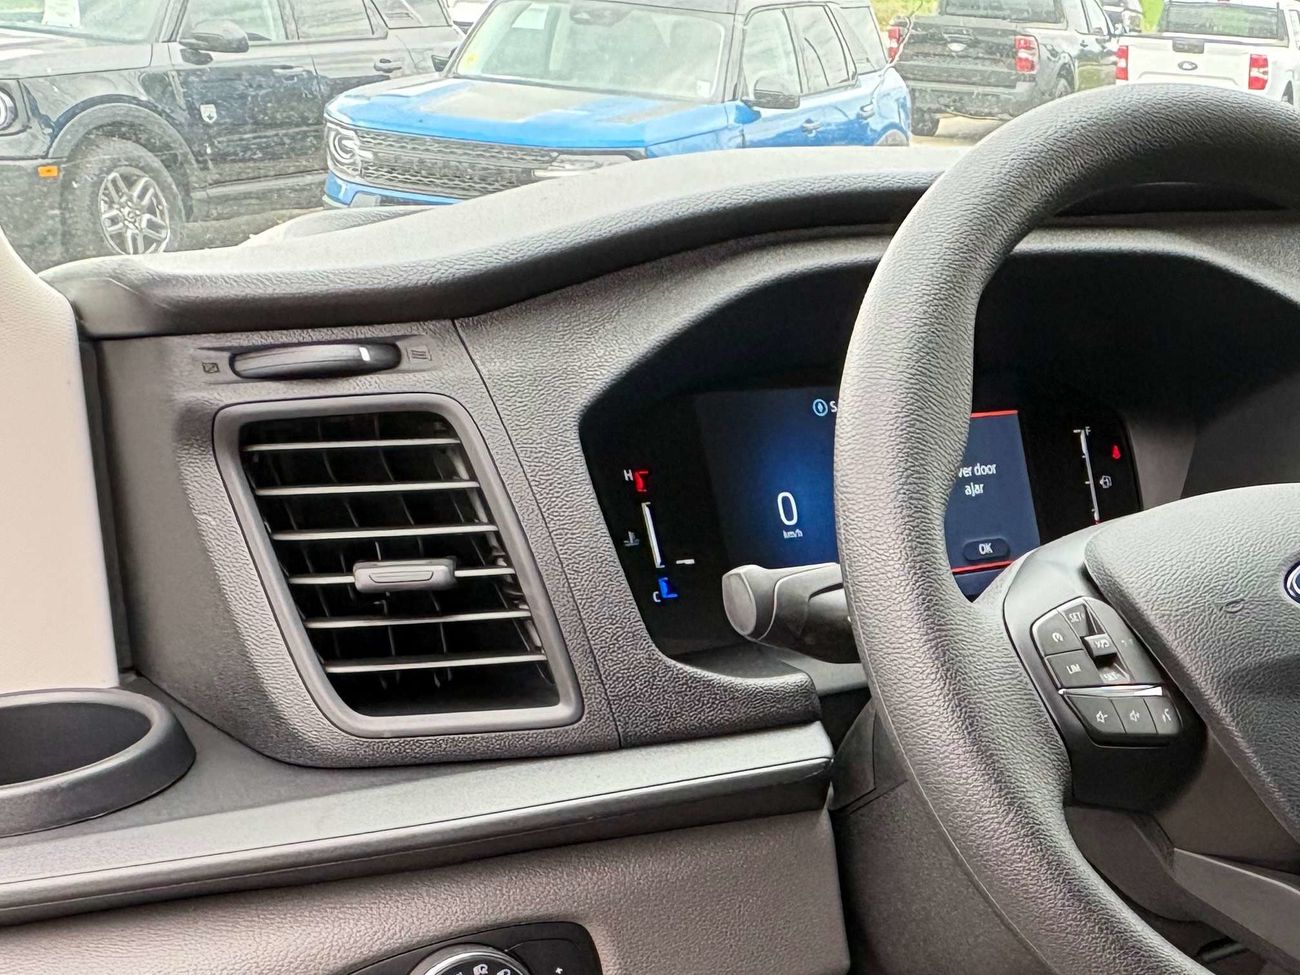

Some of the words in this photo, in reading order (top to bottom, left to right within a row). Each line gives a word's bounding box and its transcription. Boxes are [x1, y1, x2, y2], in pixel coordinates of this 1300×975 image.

[623, 469, 634, 481] H
[974, 462, 997, 476] door
[964, 482, 984, 497] ajar
[777, 491, 798, 526] 0
[978, 543, 993, 555] OK
[652, 591, 661, 602] C
[1066, 663, 1082, 675] LIM
